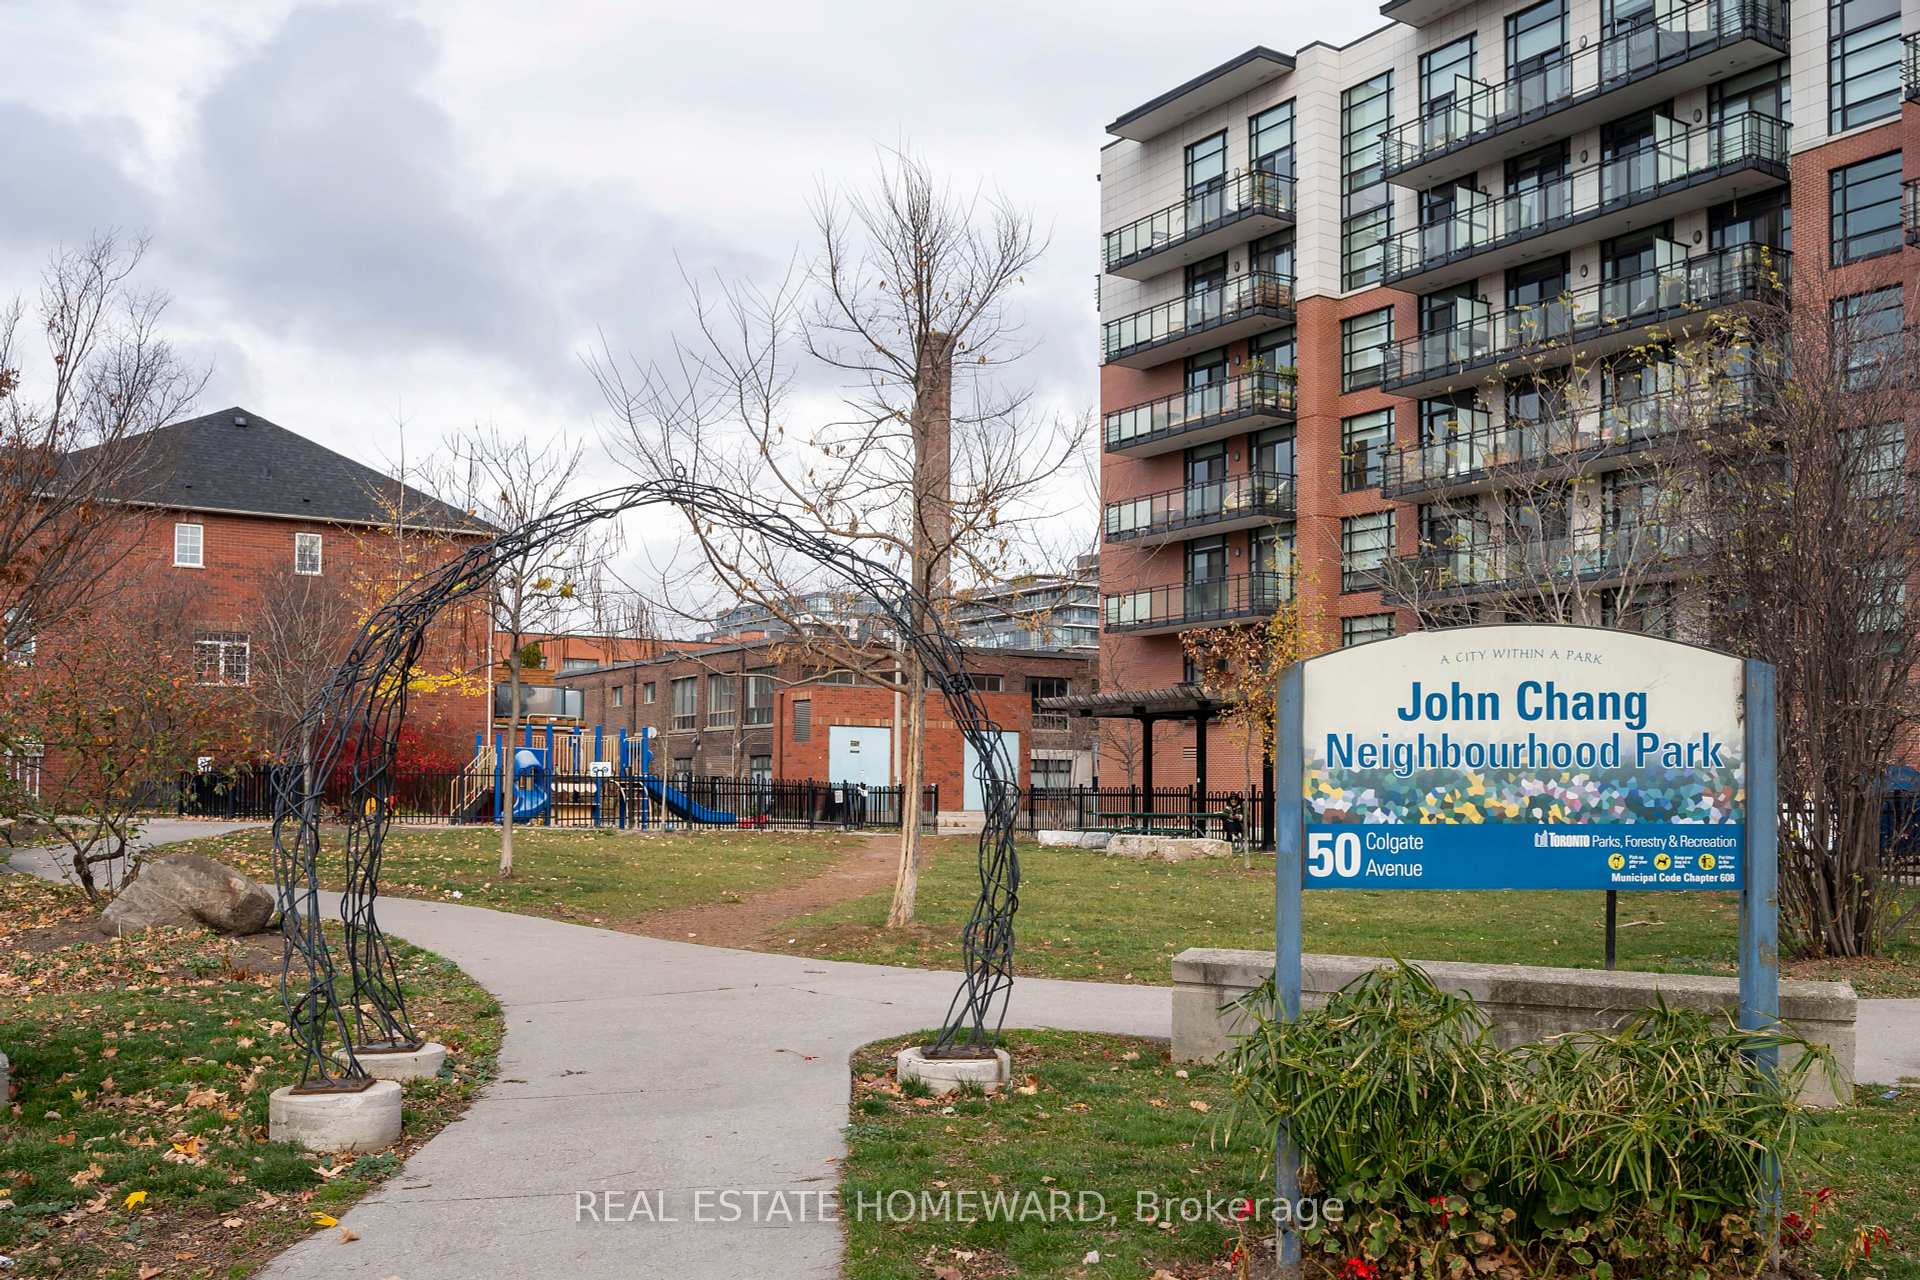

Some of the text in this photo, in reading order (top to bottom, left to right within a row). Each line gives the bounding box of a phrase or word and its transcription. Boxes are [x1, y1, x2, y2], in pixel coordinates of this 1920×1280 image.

[1440, 648, 1603, 665] A CITY WITHIN A PARK
[1397, 681, 1648, 730] John Chang
[1326, 732, 1725, 778] Neighbourhood Park
[1366, 832, 1424, 854] Colgate
[1548, 832, 1737, 850] TORONTO Parks, Forestry & Recreation
[1308, 832, 1361, 877] 50
[1365, 858, 1422, 877] Avenue
[1611, 873, 1656, 884] Municipal
[1659, 873, 1681, 882] Code
[1683, 873, 1718, 884] Chapter
